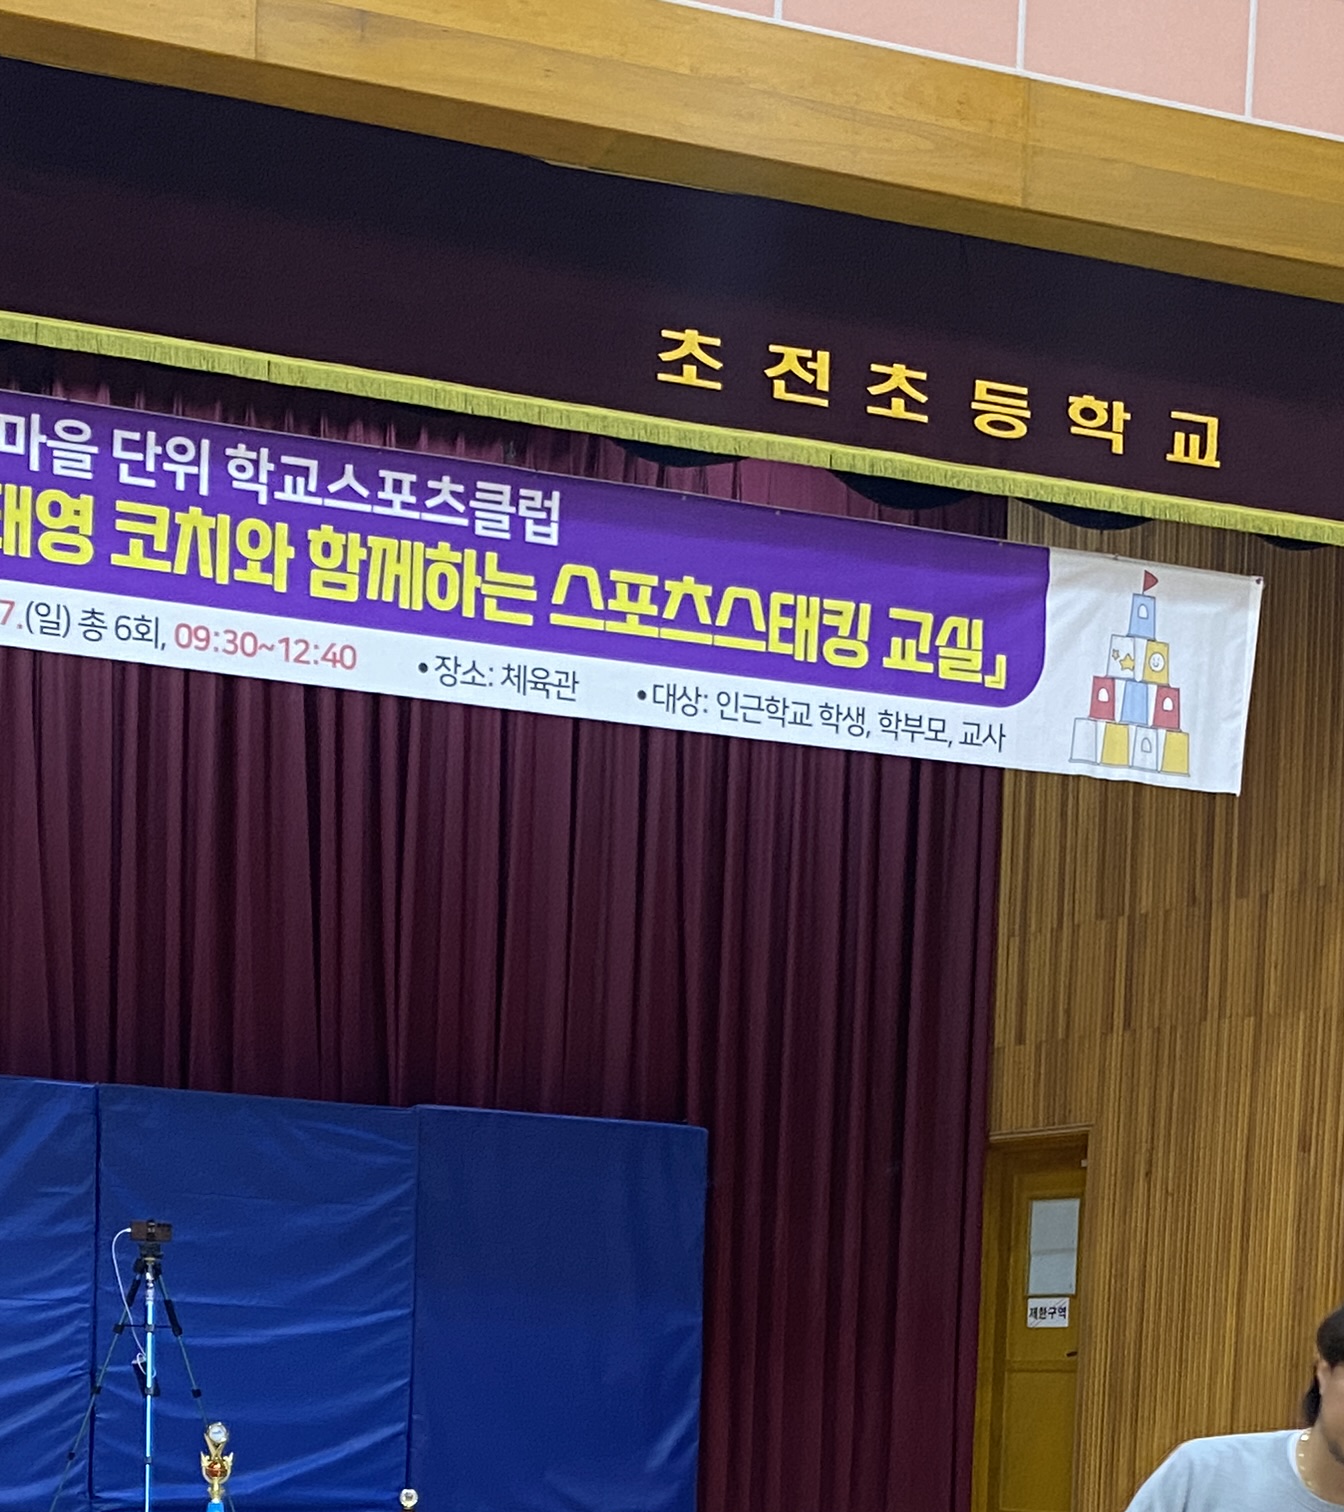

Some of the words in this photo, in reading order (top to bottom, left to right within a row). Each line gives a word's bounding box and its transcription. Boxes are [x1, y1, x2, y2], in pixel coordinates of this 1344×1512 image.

[656, 328, 1221, 469] 초전초등학교
[112, 428, 210, 497] 단위
[225, 443, 561, 547] 학교스포츠클럽
[111, 501, 294, 592] 코치와
[308, 525, 536, 625] 함께하는
[550, 564, 870, 668] 스포츠스태킹
[76, 607, 109, 643] 총
[113, 613, 167, 652] 6회,
[174, 622, 358, 671] 09:30~12:40
[433, 654, 494, 688] 장소:
[499, 662, 581, 703] 체육관
[652, 682, 709, 718] 대상:
[715, 690, 814, 729] 인근학교
[817, 701, 872, 740] 학생,
[877, 708, 954, 749] 학부모,
[957, 720, 1007, 754] 교사
[1029, 1306, 1067, 1320] 제한구역
